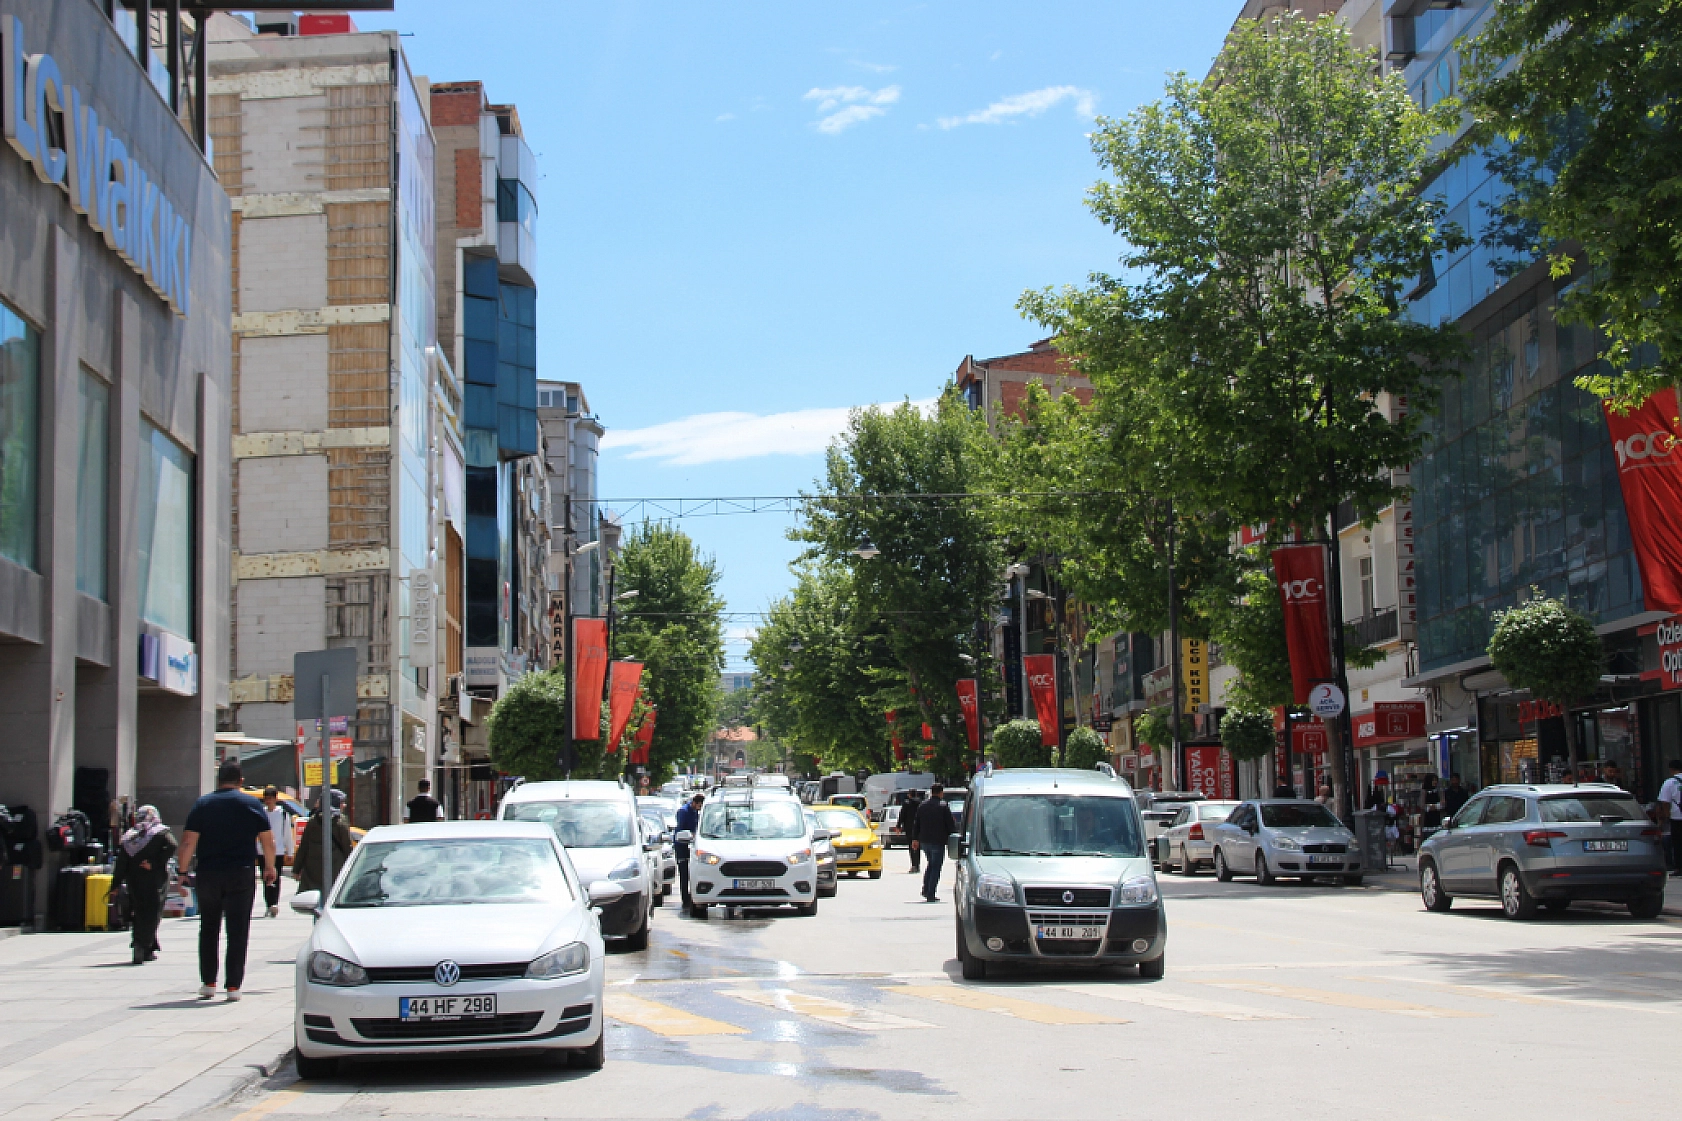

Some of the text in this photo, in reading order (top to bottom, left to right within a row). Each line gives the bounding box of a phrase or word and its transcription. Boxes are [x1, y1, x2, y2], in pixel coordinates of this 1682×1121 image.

[409, 997, 493, 1015] 44 HF 298
